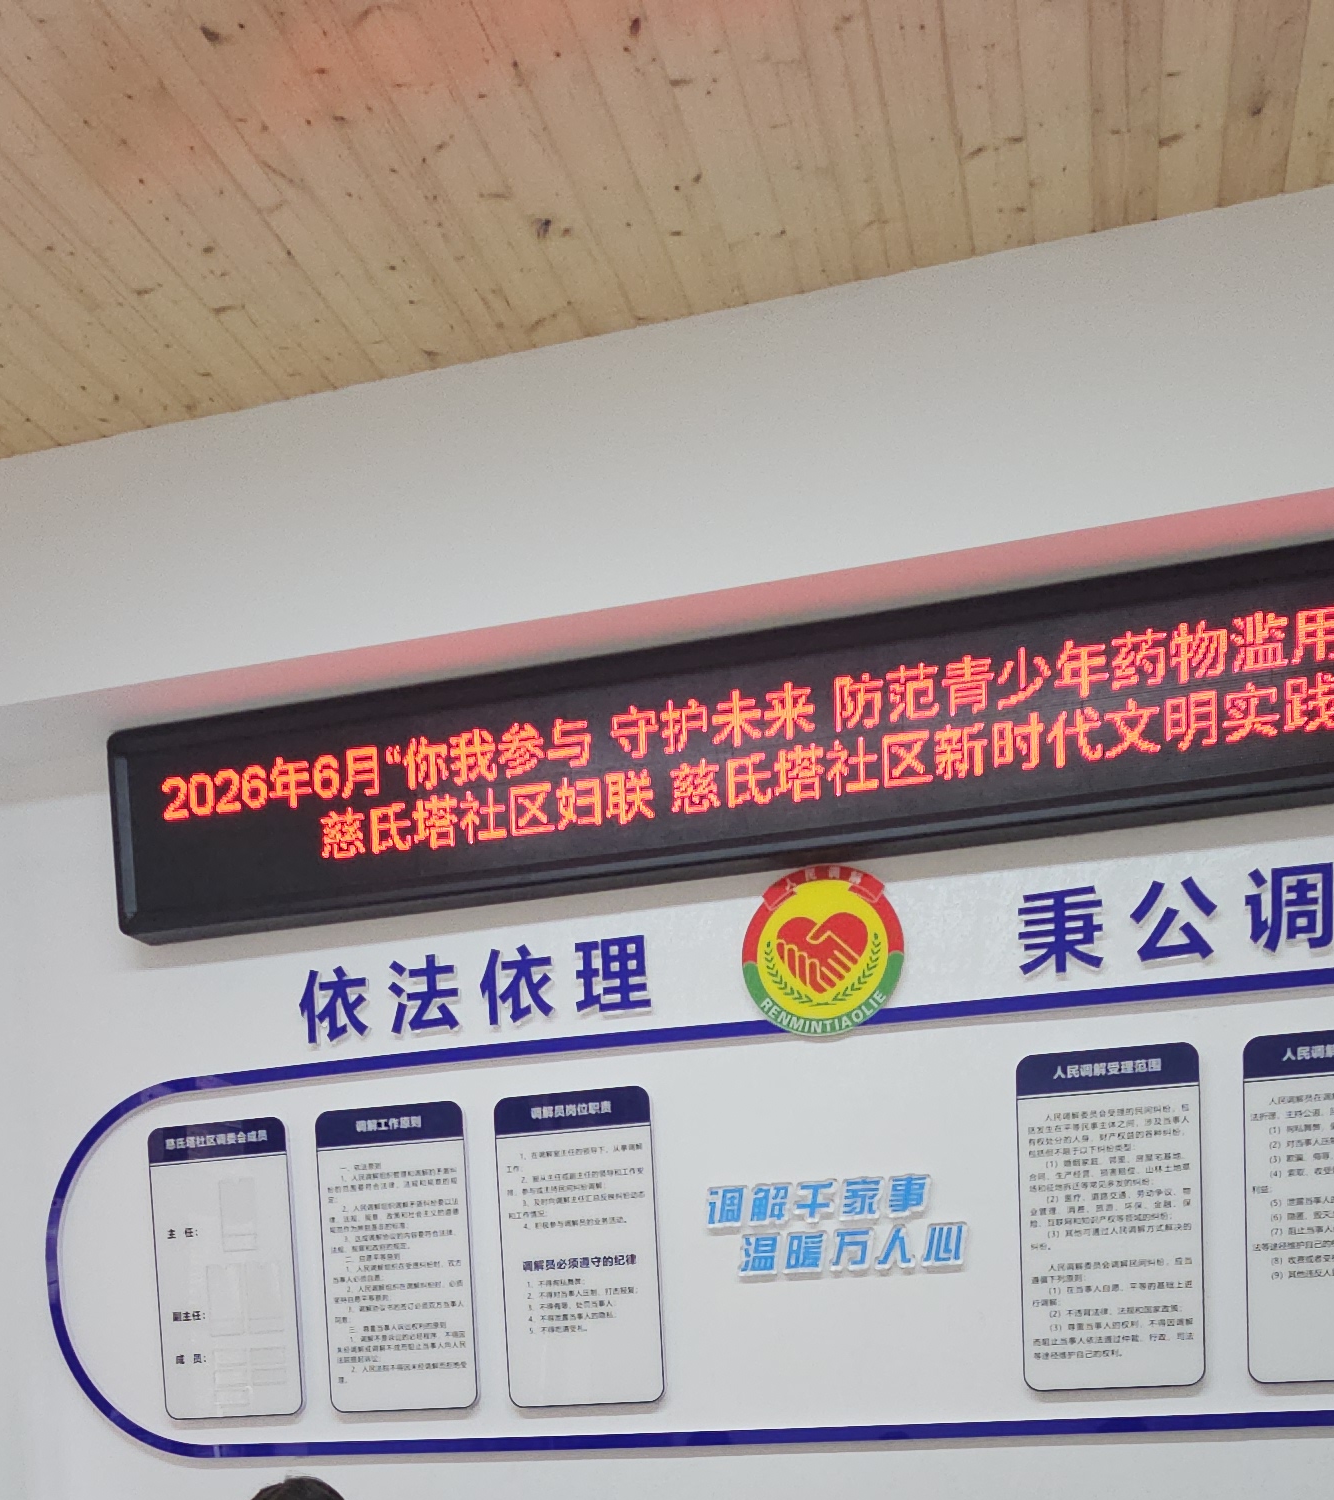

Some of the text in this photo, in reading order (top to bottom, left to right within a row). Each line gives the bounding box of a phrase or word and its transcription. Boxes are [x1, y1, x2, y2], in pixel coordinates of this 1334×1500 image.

[610, 680, 815, 758] 守护未来
[320, 770, 655, 861] 慈氏塔社区妇联
[299, 935, 651, 1045] 依法依理
[1053, 1058, 1162, 1079] 人民调解受理范围
[355, 1115, 422, 1133] 调解工作原则
[530, 1100, 612, 1120] 调解员岗位职责
[707, 1174, 927, 1225] 调解千家事
[523, 1254, 637, 1272] 调解员必须遵守的纪律
[740, 1224, 964, 1272] 温暖万人心
